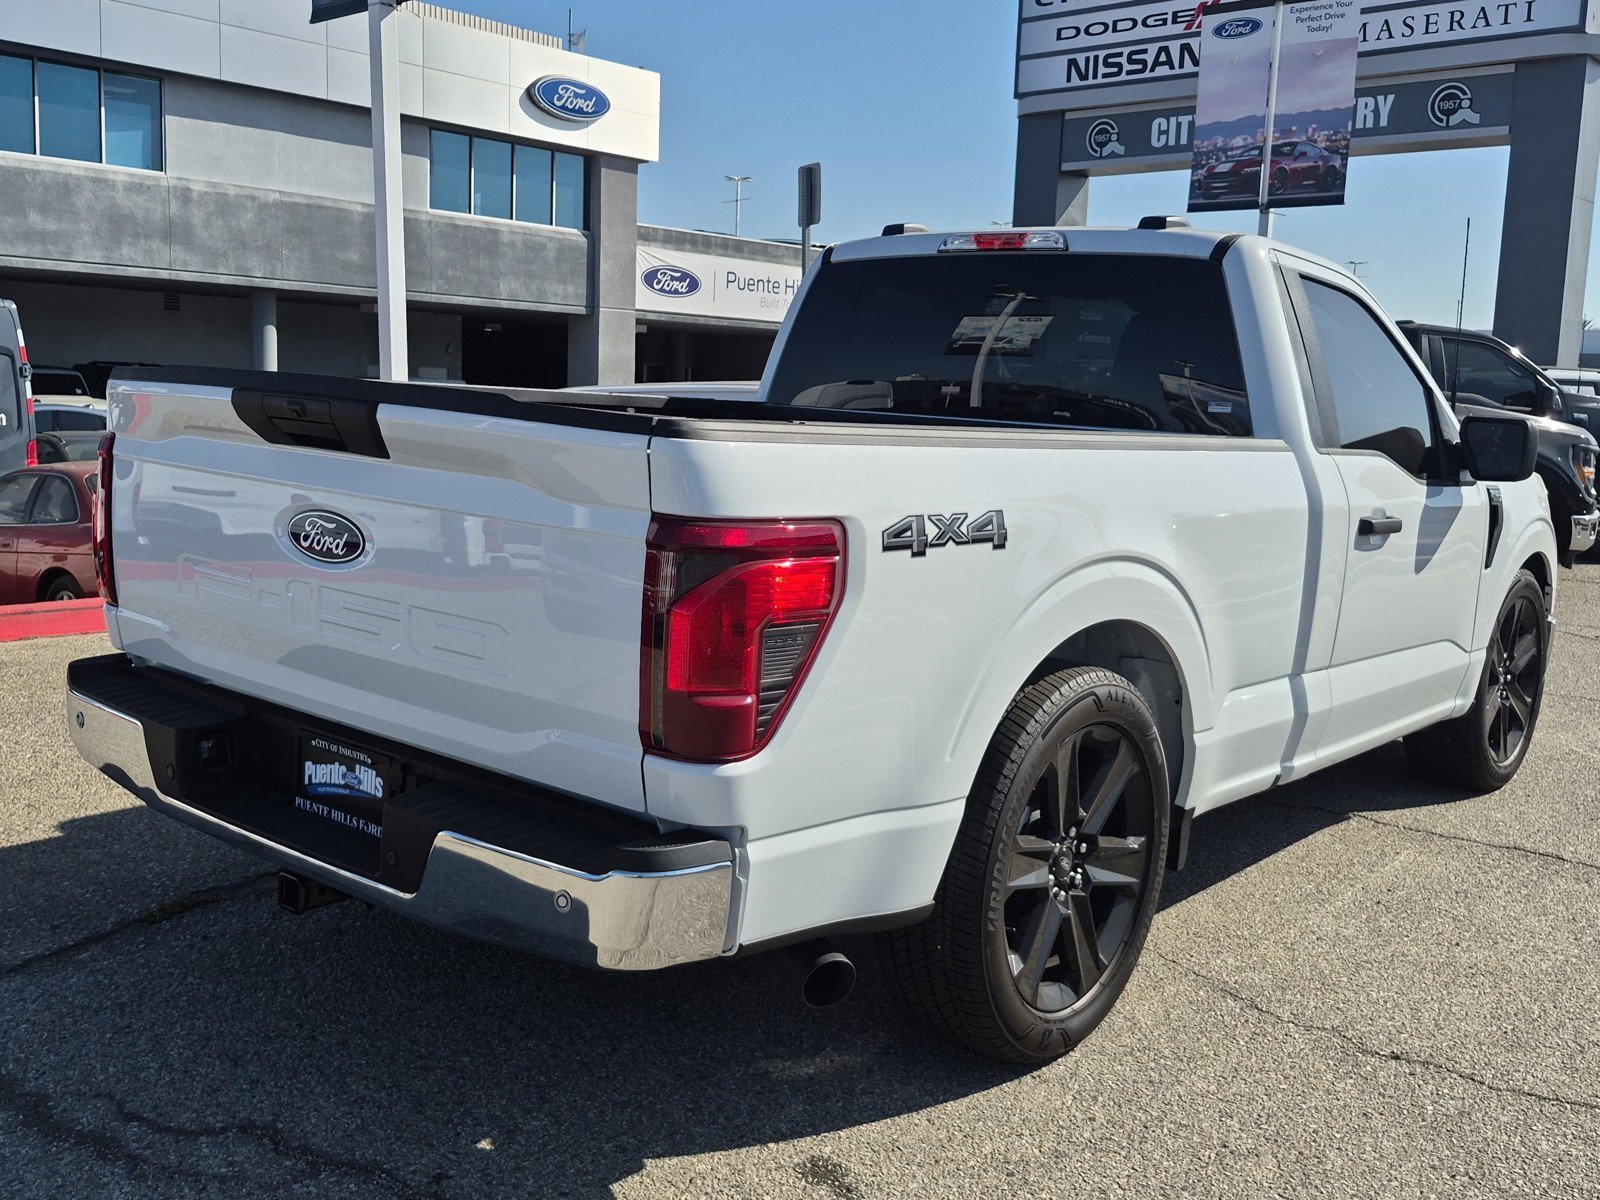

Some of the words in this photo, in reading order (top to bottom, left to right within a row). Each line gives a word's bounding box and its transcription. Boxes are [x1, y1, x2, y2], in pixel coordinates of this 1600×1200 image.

[1289, 4, 1333, 15] Experience
[1335, 0, 1353, 8] Your
[1295, 15, 1322, 24] Perfect
[1324, 11, 1346, 20] Drive
[1055, 9, 1196, 41] DODGE
[1222, 20, 1253, 37] Ford
[1306, 24, 1333, 33] Today!
[1065, 42, 1200, 83] NISSAN
[553, 84, 597, 113] Ford
[1438, 99, 1459, 110] 1957
[1150, 115, 1196, 148] CIT
[653, 270, 690, 293] Ford
[725, 271, 781, 295] Puente
[760, 297, 780, 310] Built
[300, 517, 349, 556] Ford
[177, 552, 509, 679] F-150
[765, 636, 804, 647] FORD
[315, 739, 329, 750] CITY
[330, 743, 338, 752] OF
[339, 746, 368, 761] INDUSTRY
[305, 761, 347, 785] Puente
[355, 764, 384, 798] Hills
[295, 796, 329, 817] PUENTE
[331, 809, 357, 828] HILLS
